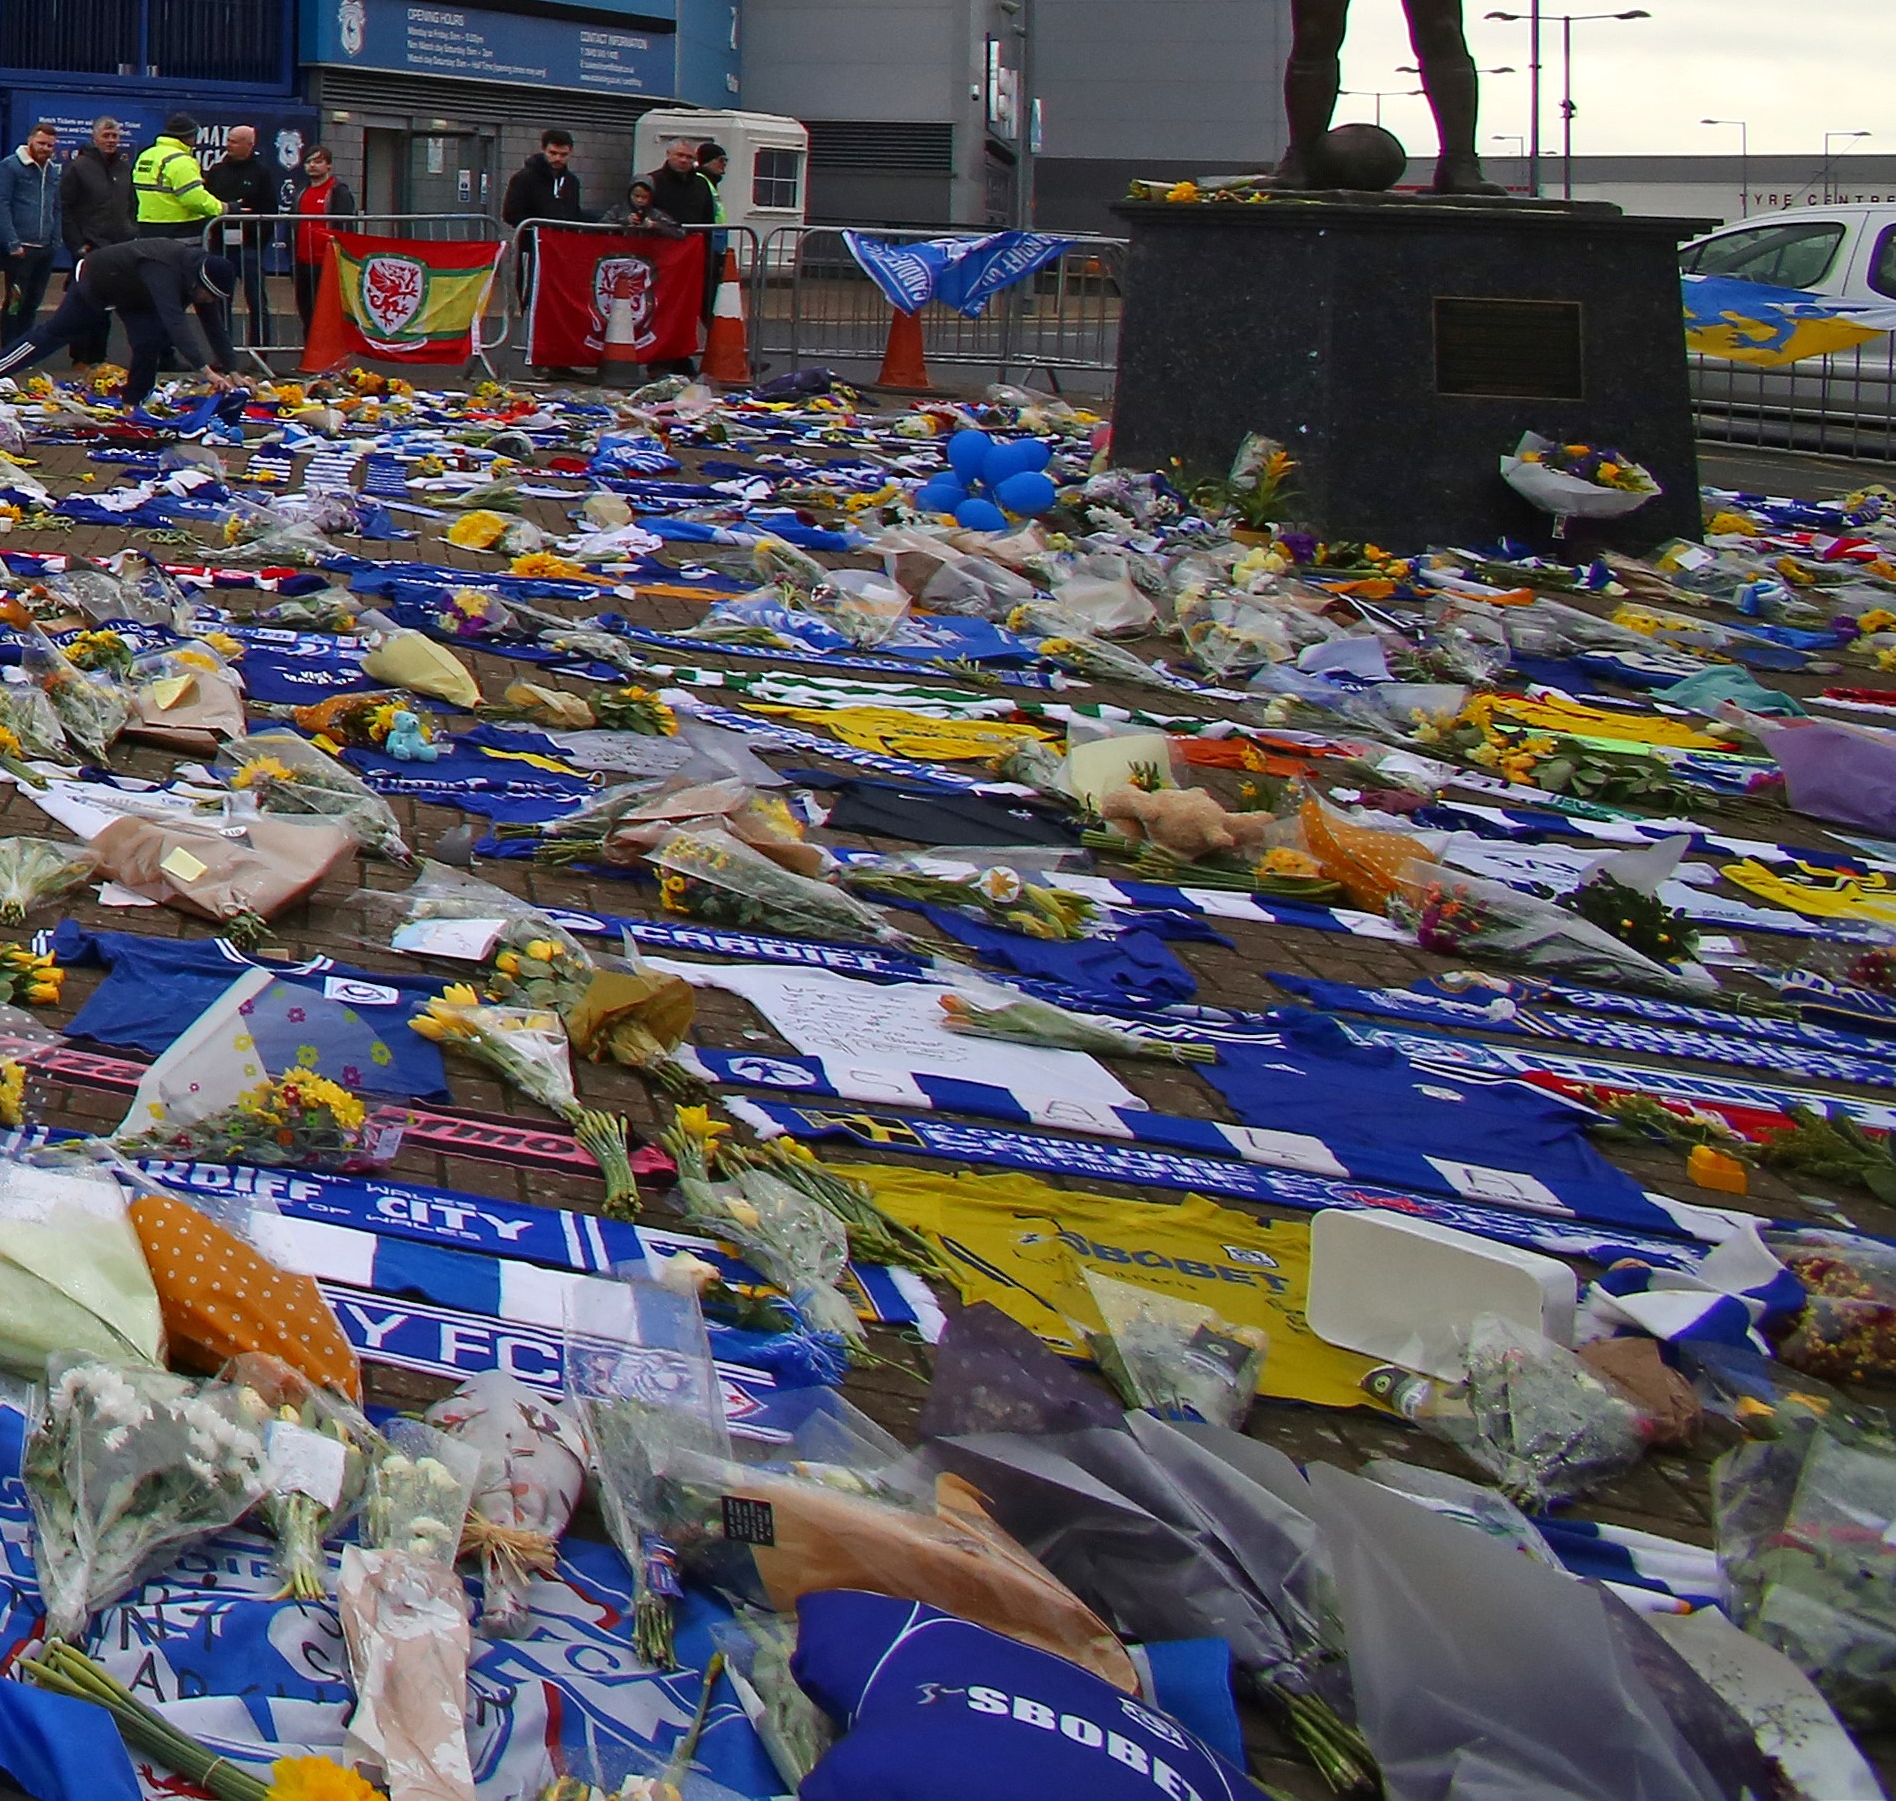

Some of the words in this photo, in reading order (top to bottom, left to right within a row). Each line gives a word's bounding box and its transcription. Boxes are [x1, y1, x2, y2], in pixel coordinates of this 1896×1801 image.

[1739, 193, 1793, 206] TYRE
[365, 1213, 482, 1241] WALES
[375, 1197, 534, 1241] CITY
[439, 1318, 564, 1386] FC
